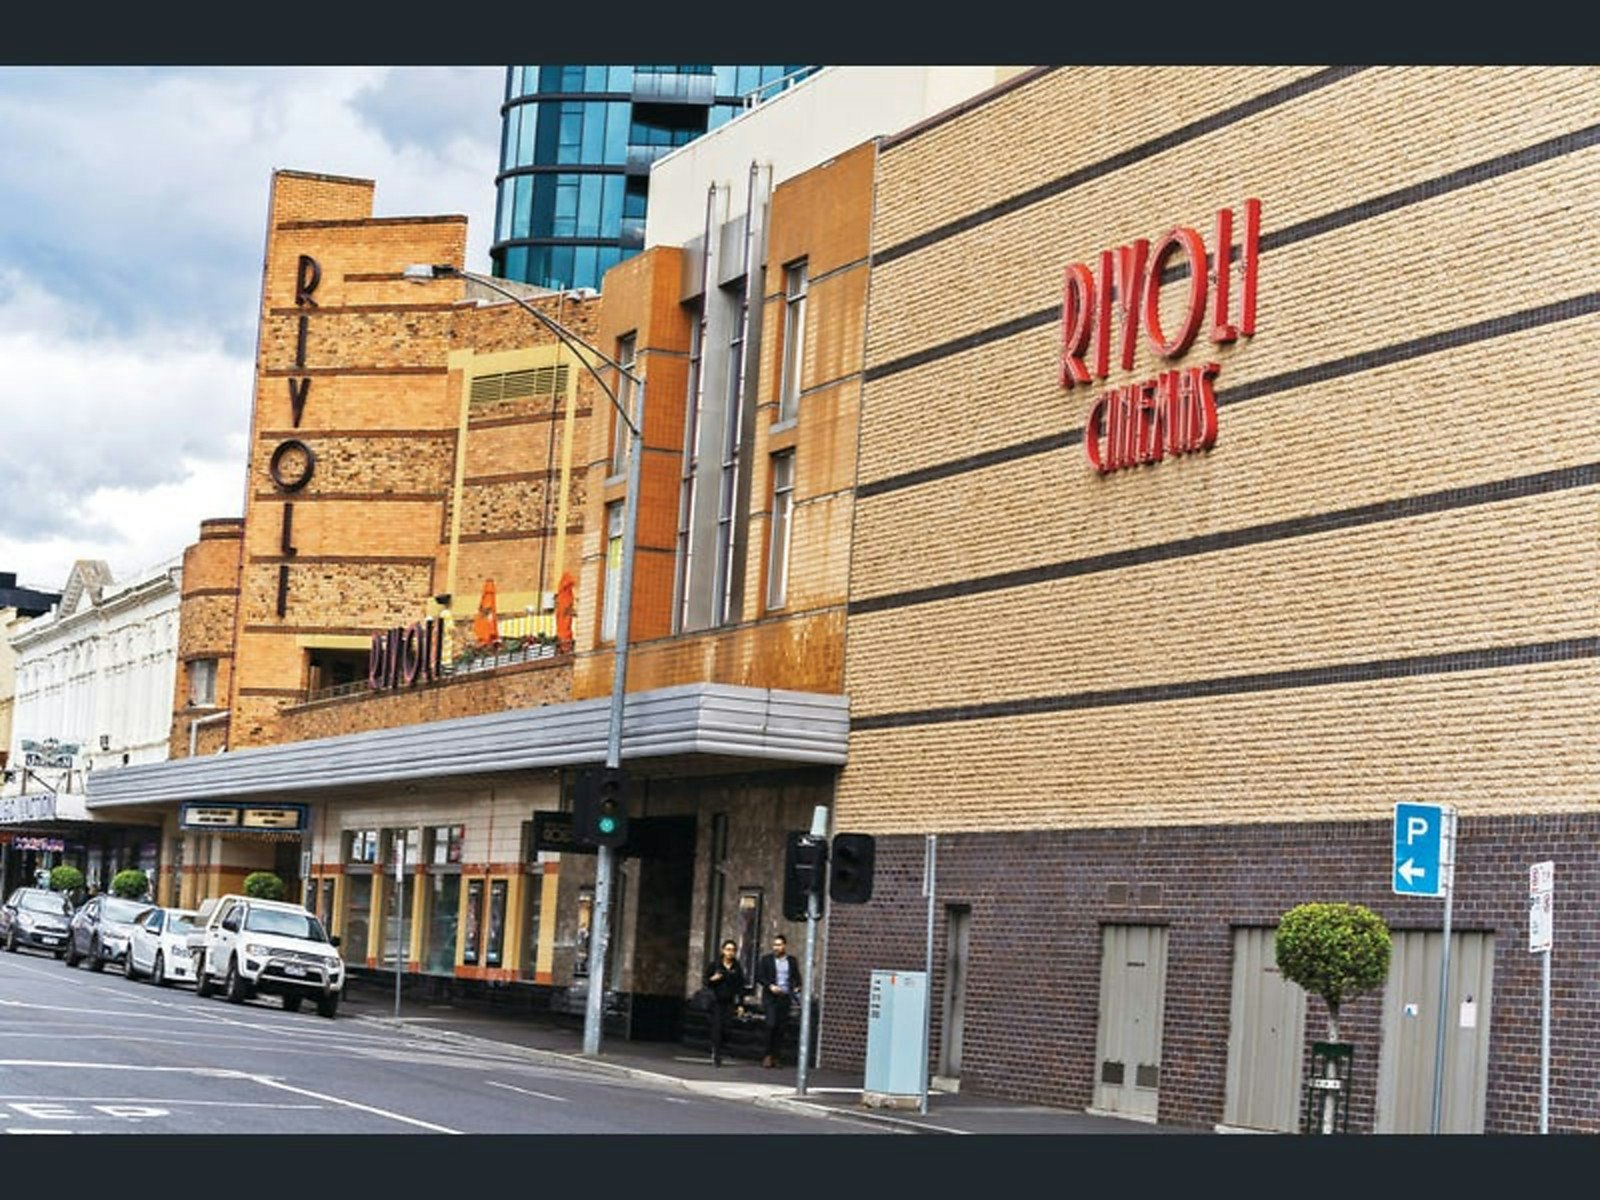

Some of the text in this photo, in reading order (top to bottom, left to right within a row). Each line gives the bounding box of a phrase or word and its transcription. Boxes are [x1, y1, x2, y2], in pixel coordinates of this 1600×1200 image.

[1060, 198, 1261, 388] RIVOLI
[270, 255, 320, 617] RIVOLI
[1085, 362, 1220, 473] CINEMAS
[368, 617, 444, 689] RIVOLI
[1407, 817, 1428, 845] P
